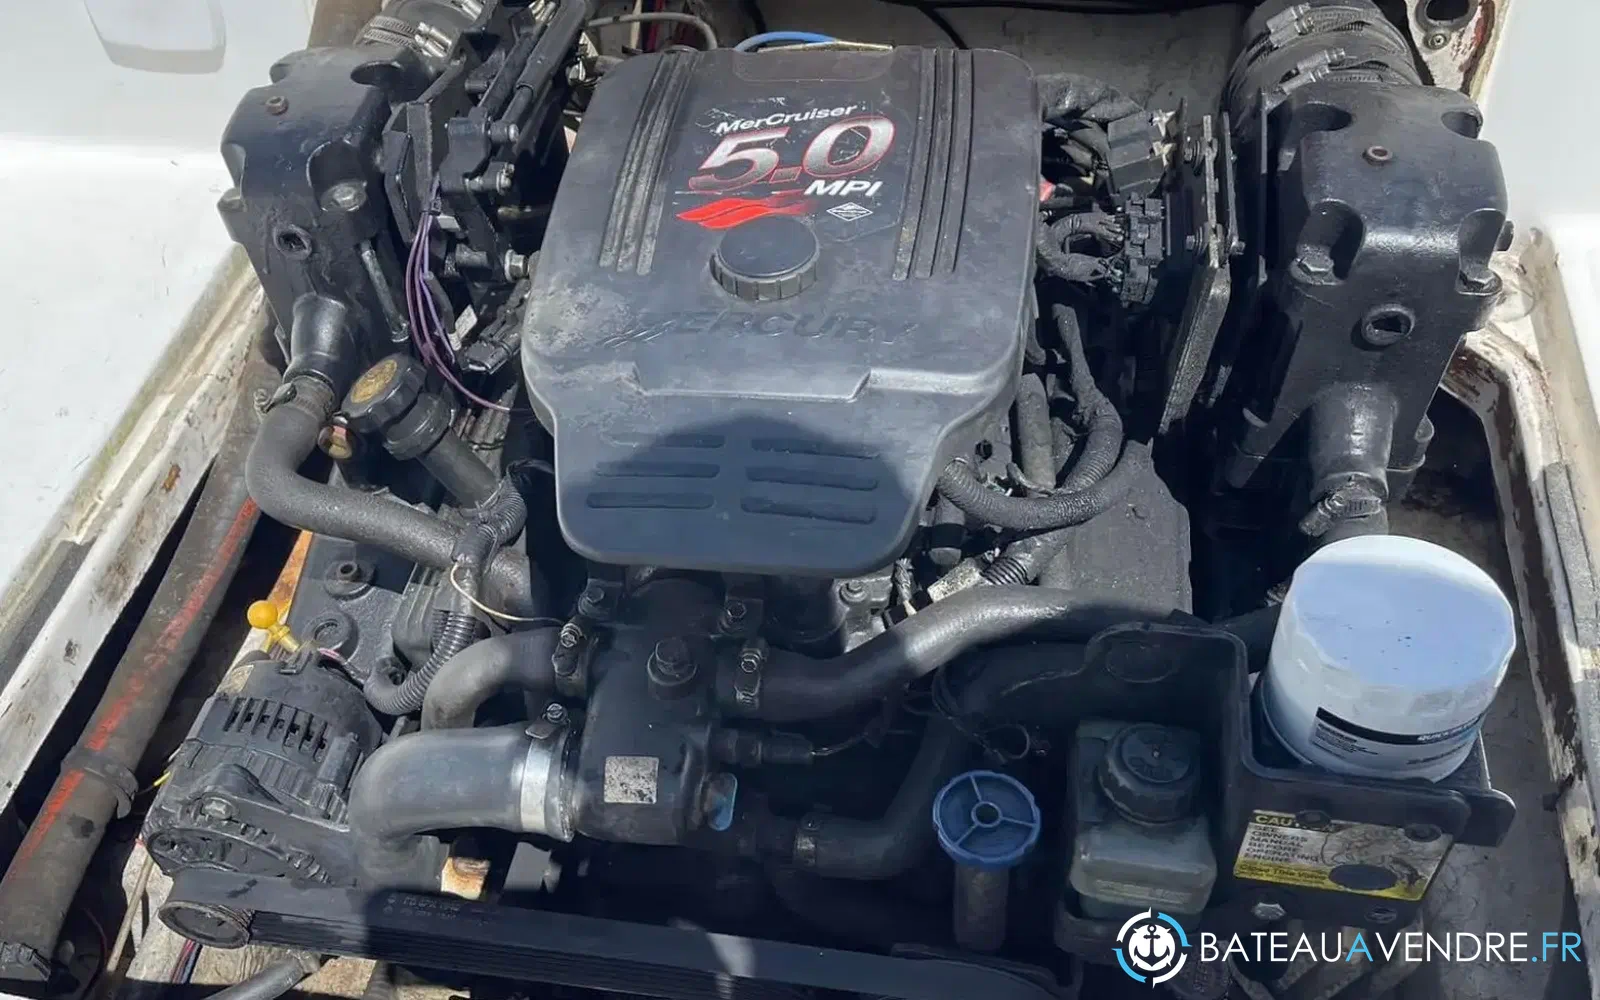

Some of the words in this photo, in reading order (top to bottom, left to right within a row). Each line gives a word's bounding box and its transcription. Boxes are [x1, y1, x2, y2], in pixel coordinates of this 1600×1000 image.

[715, 104, 857, 134] MerCruiser
[689, 115, 895, 194] 5.0
[804, 180, 883, 197] MPI
[598, 309, 919, 347] ERCURY
